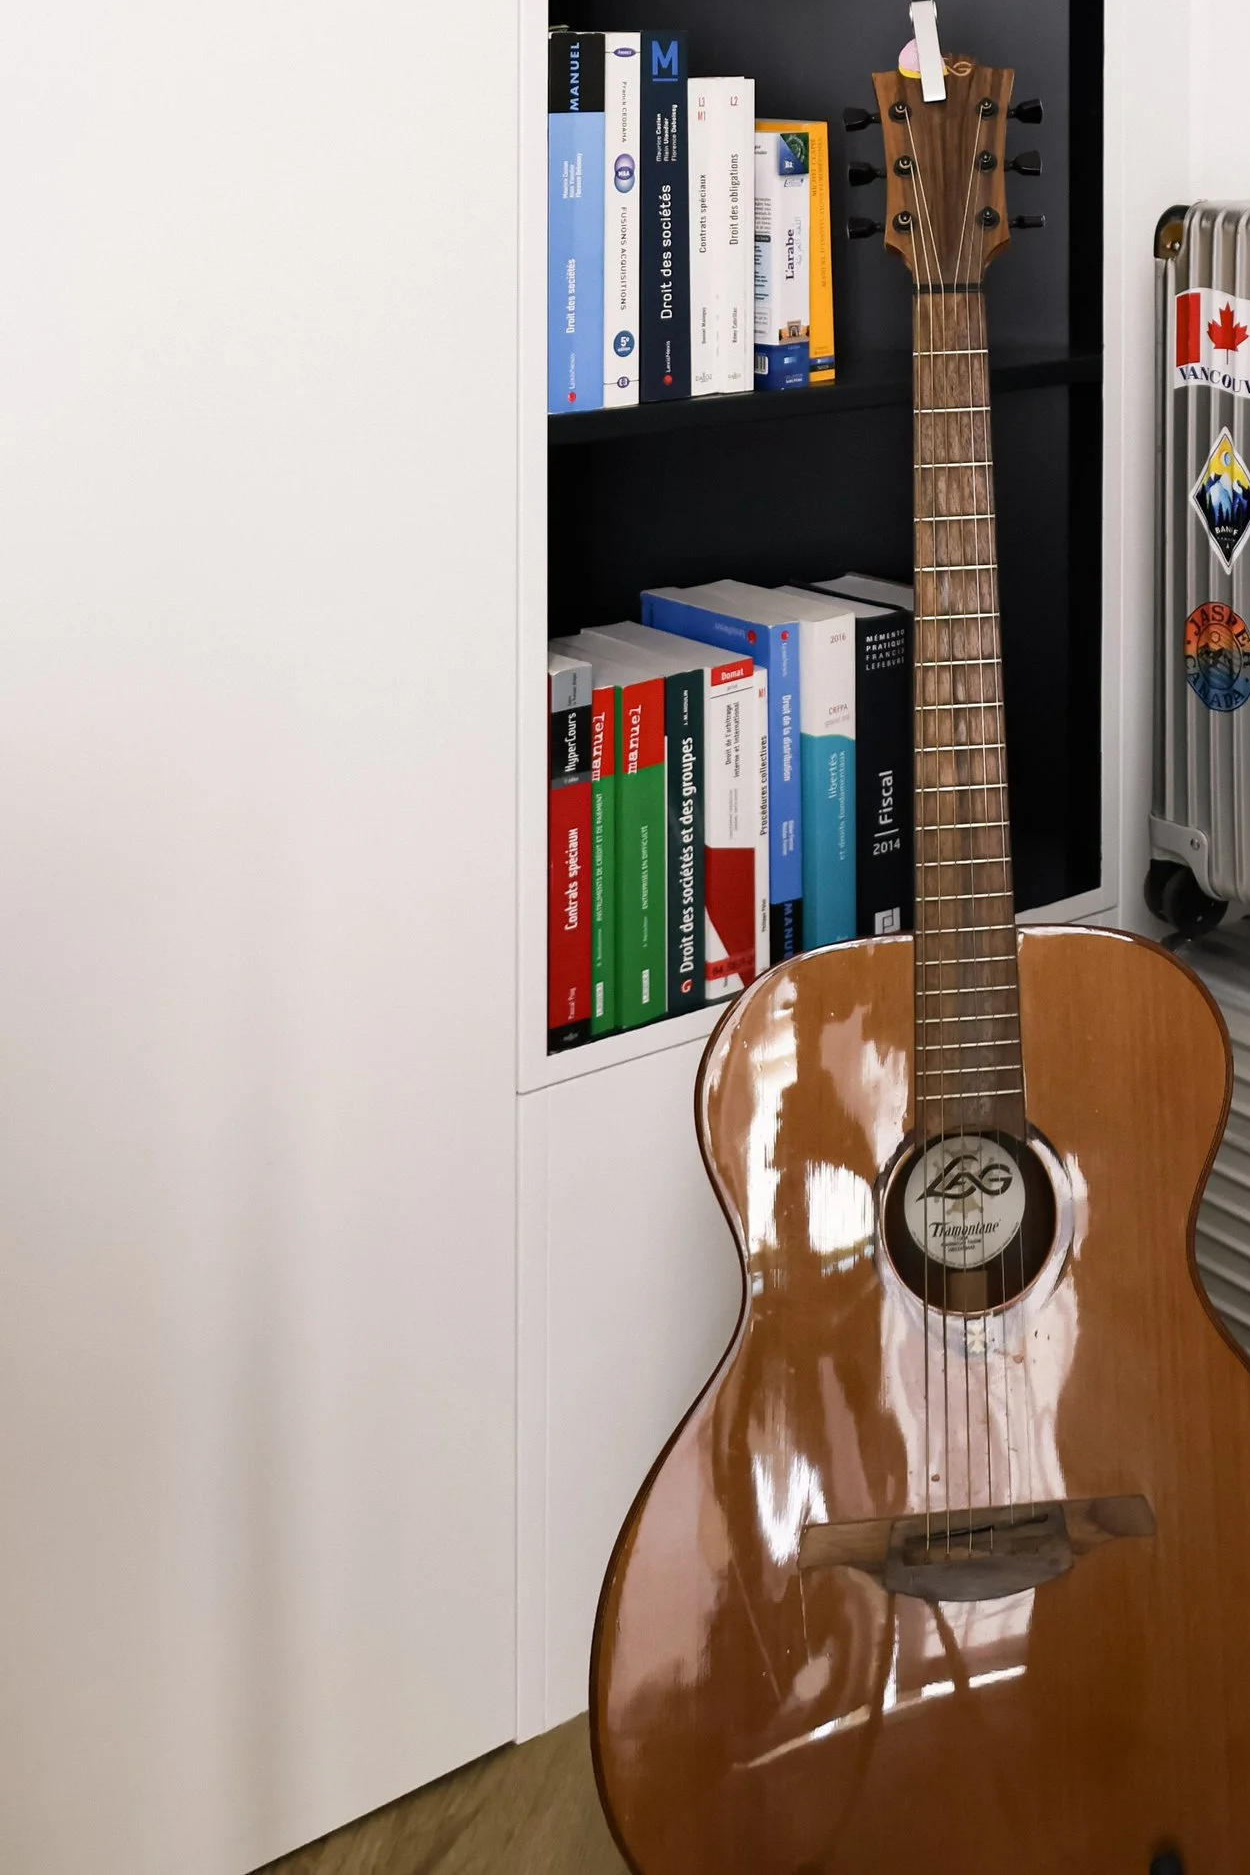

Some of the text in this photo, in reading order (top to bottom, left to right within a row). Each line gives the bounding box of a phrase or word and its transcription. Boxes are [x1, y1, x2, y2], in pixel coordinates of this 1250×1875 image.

[569, 42, 580, 112] MANUEL
[652, 40, 679, 76] M
[618, 169, 631, 178] MBA
[698, 174, 708, 254] Contrats spéciaux
[728, 153, 741, 246] Droit des obligations
[620, 206, 628, 311] FUSIONS ACQUISITIONS
[658, 184, 672, 320] Droit des sociétés
[786, 228, 795, 281] L'arabe
[565, 258, 577, 334] Droit des sociétés
[829, 632, 847, 645] 2016
[865, 629, 905, 643] MÉMENTO
[865, 638, 905, 652] PRATIQUE
[721, 668, 745, 681] Domat
[782, 694, 794, 714] Droit
[782, 715, 793, 725] de
[564, 712, 580, 773] HyperCours
[592, 712, 605, 782] manuel
[627, 704, 642, 775] manuel
[724, 739, 732, 747] de
[724, 748, 733, 766] Droit
[782, 736, 794, 781] distribution
[759, 735, 768, 836] Procédures collectives
[828, 752, 838, 799] libertés
[878, 769, 894, 826] Fiscal
[678, 736, 697, 974] Droit des sociétés et des groupes
[872, 837, 901, 856] 2014
[564, 828, 581, 931] Contrats spéciaux
[928, 1220, 999, 1238] Tramontane
